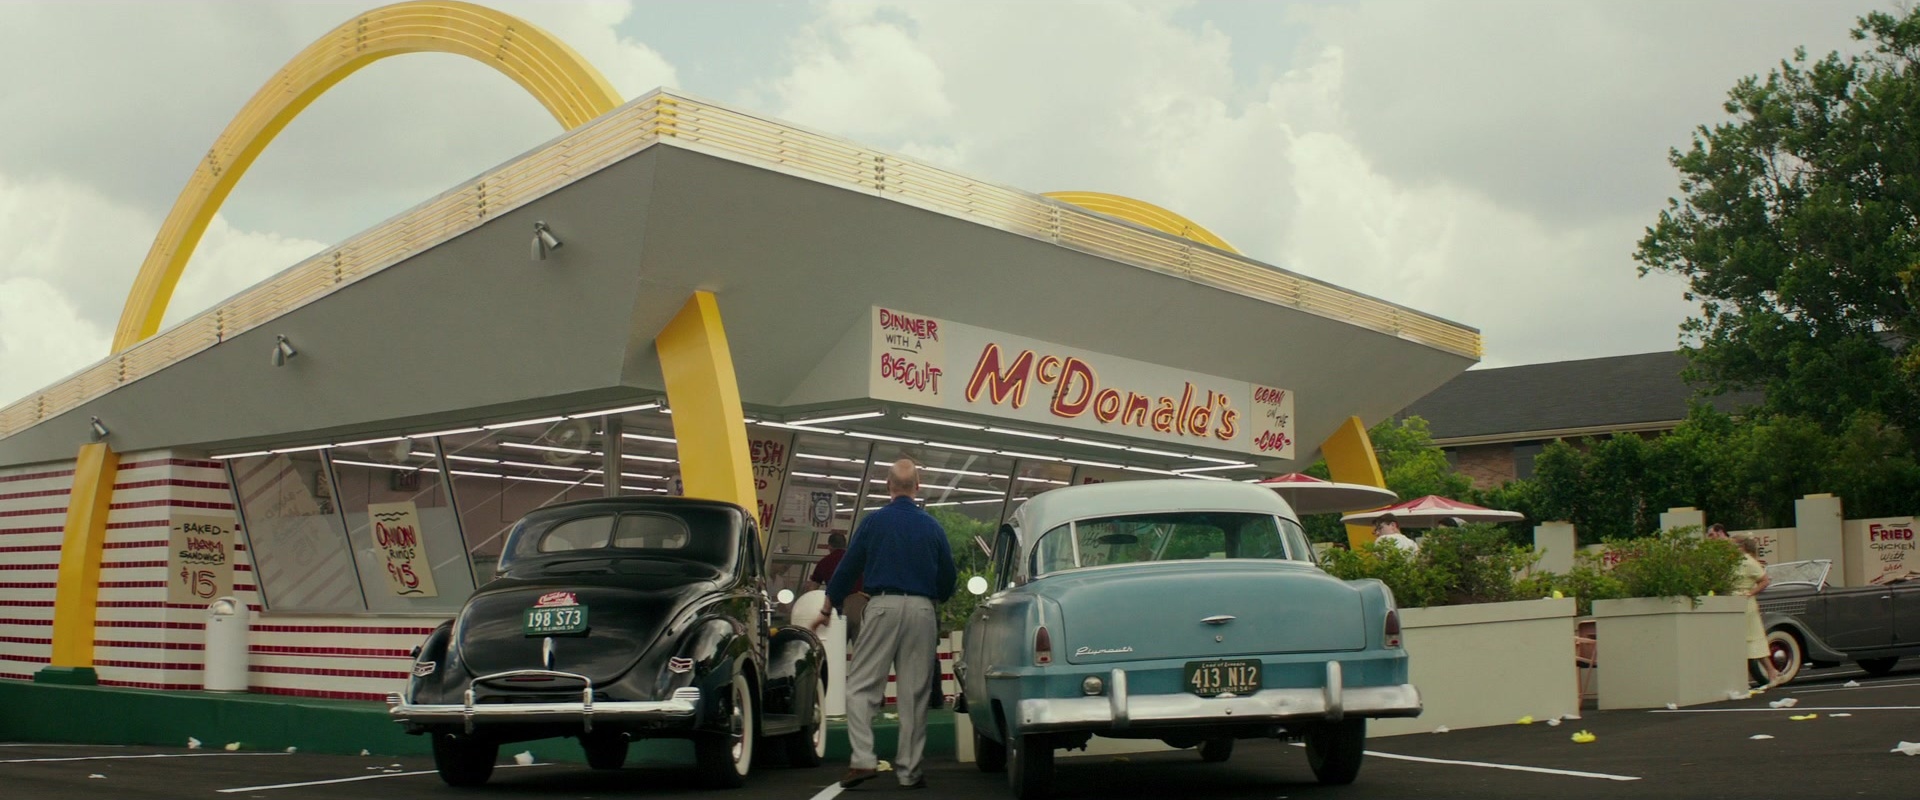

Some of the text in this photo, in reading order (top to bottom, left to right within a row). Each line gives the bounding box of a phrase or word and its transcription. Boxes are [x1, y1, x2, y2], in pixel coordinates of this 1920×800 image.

[880, 309, 939, 342] DINNER
[886, 334, 922, 350] WITH A
[881, 353, 943, 395] BISCUIT
[965, 343, 1240, 441] McDonald's
[1254, 387, 1285, 406] CORN
[1266, 407, 1278, 419] ON
[1275, 413, 1288, 428] THE
[750, 440, 784, 466] ESH
[376, 522, 417, 549] ONION
[1869, 523, 1913, 541] FRIED
[187, 537, 223, 554] HAM
[1870, 541, 1916, 551] CHICKEN
[179, 551, 225, 562] SANDWICH
[389, 548, 416, 564] Rings
[528, 610, 581, 628] 198 S73
[1075, 646, 1133, 657] Plymouth
[1191, 667, 1257, 688] 413 N12
